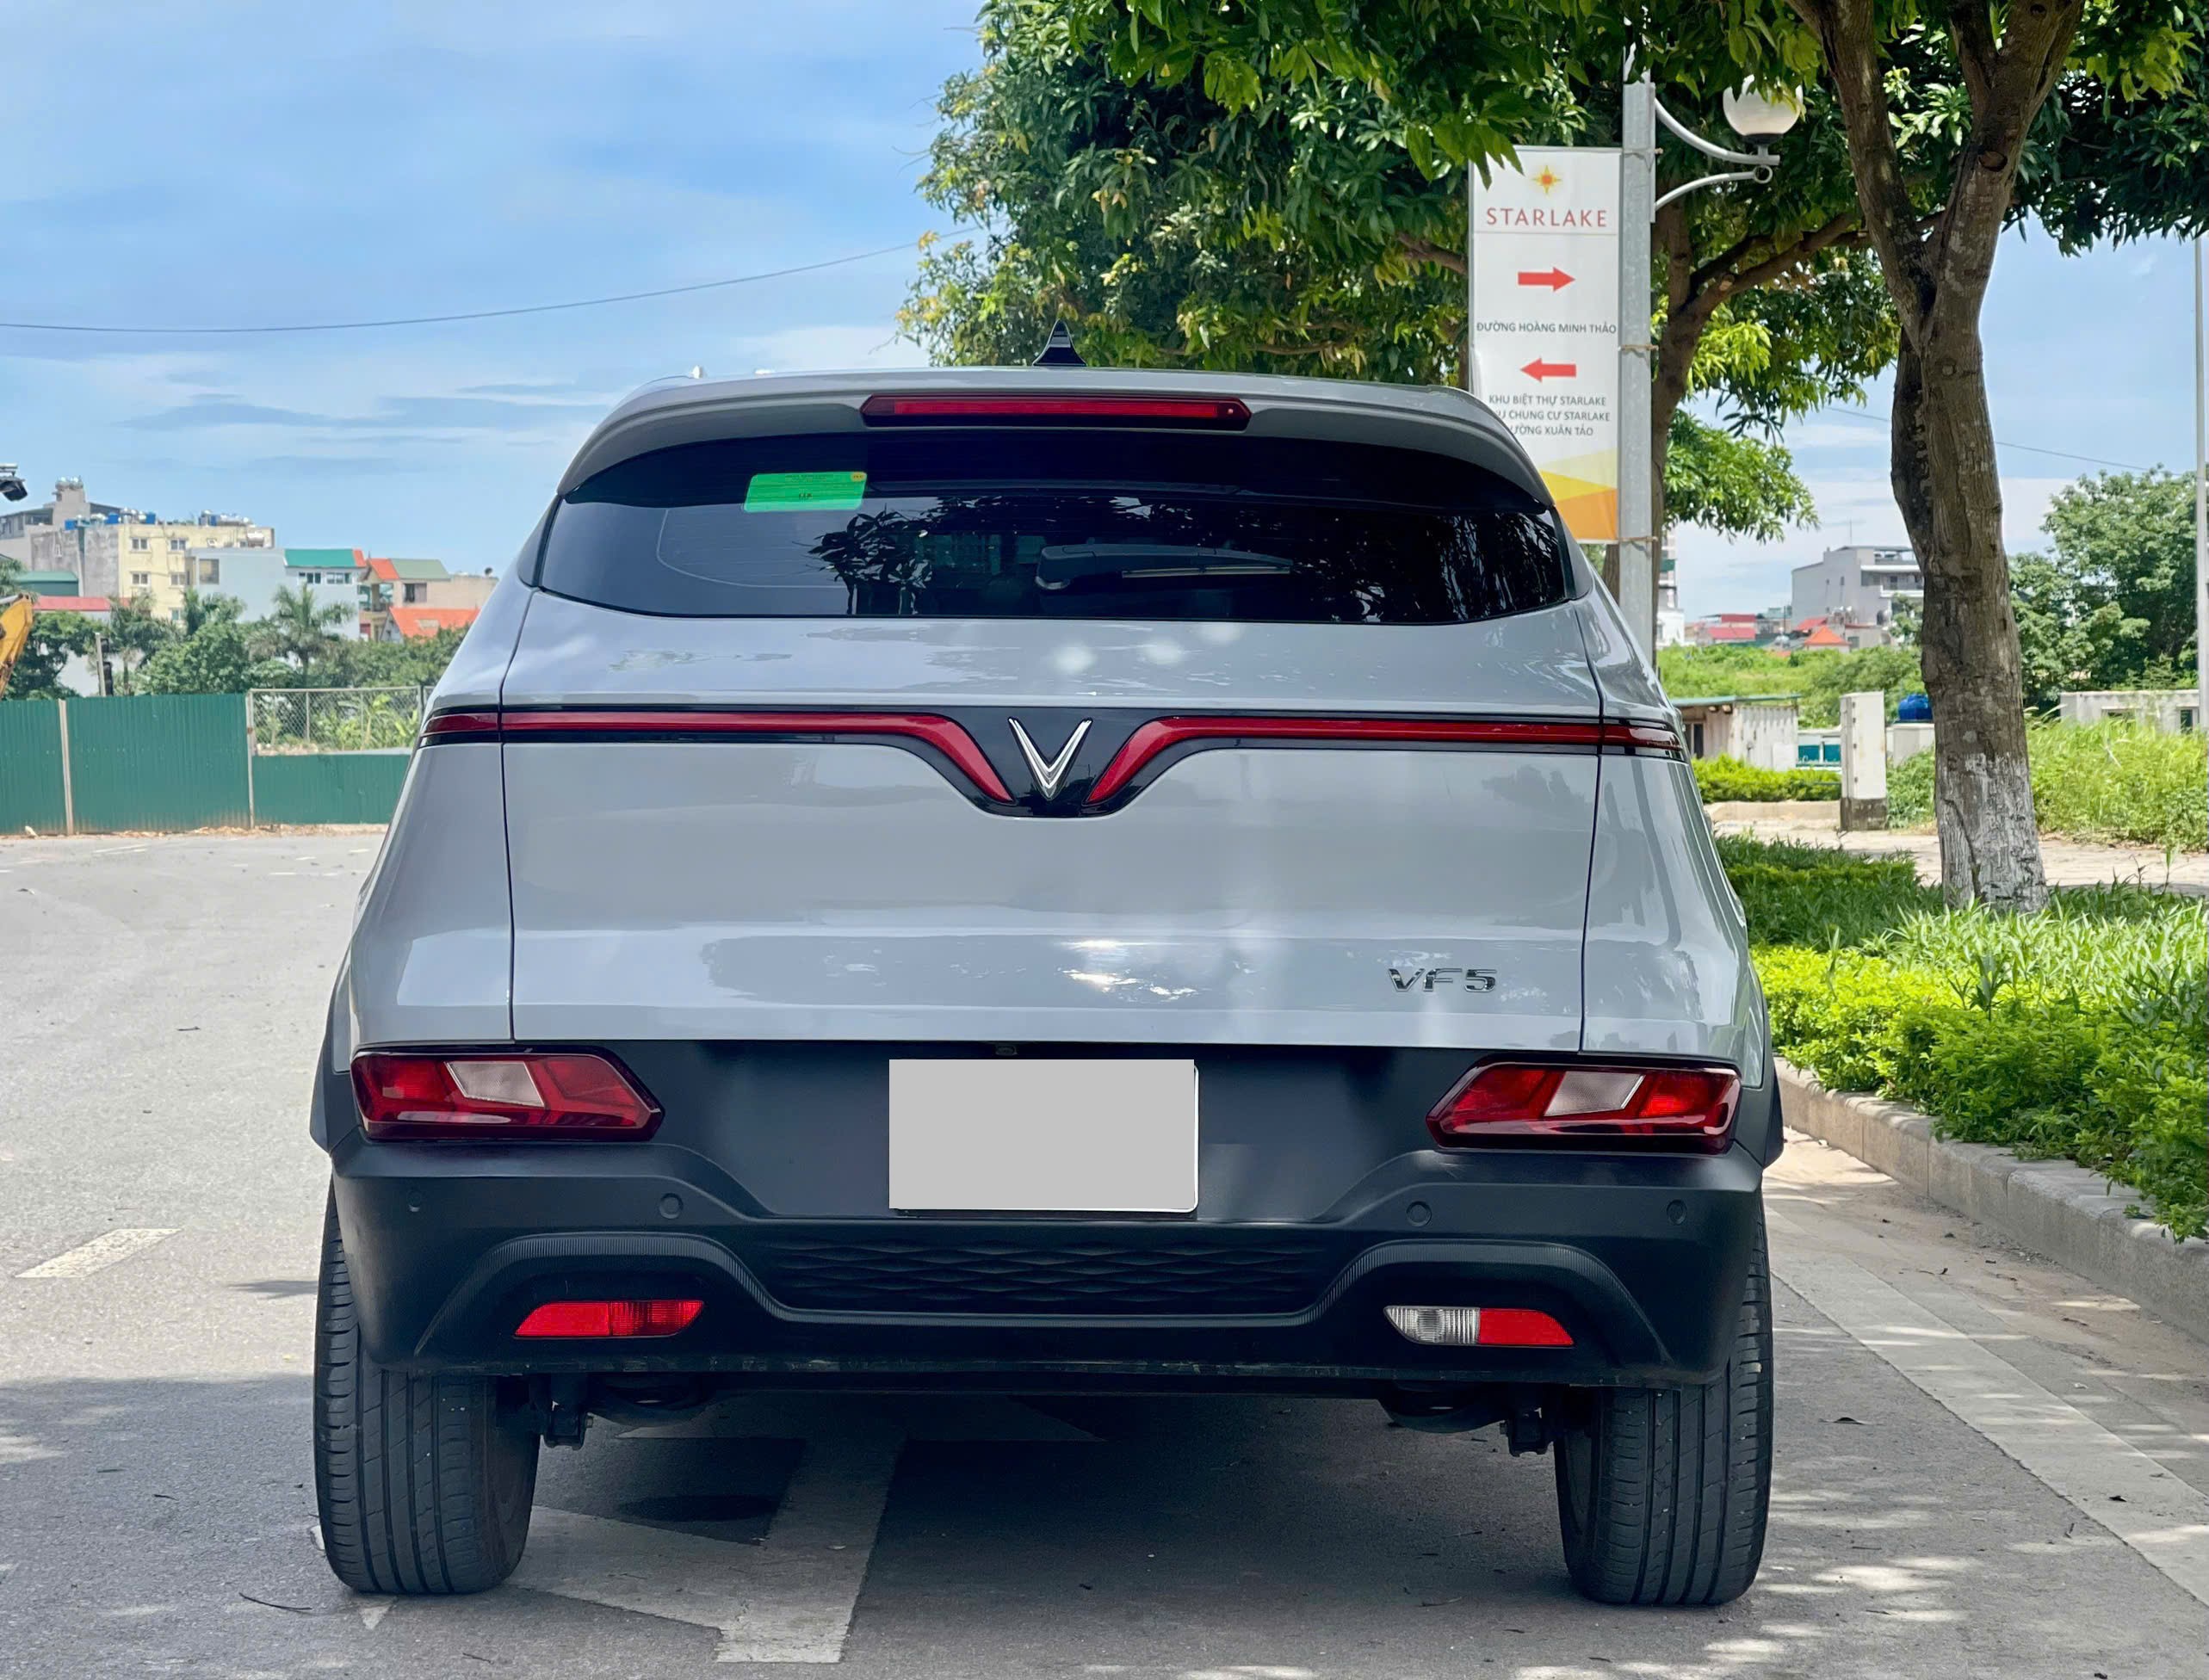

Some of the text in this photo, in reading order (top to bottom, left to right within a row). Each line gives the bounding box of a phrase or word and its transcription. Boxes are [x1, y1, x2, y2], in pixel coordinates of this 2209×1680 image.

[1487, 207, 1607, 227] STARLAKE
[1476, 320, 1617, 334] ĐƯỜNG HOÀNG MINH THẢO
[1489, 394, 1607, 407] KHU BIỆT THỰ STARLAKE
[1508, 410, 1544, 421] CHUNG
[1547, 411, 1562, 421] CƯ
[1563, 411, 1611, 422] STARLAKE
[1510, 423, 1594, 436] ƯỜNG XUÂN TẢO
